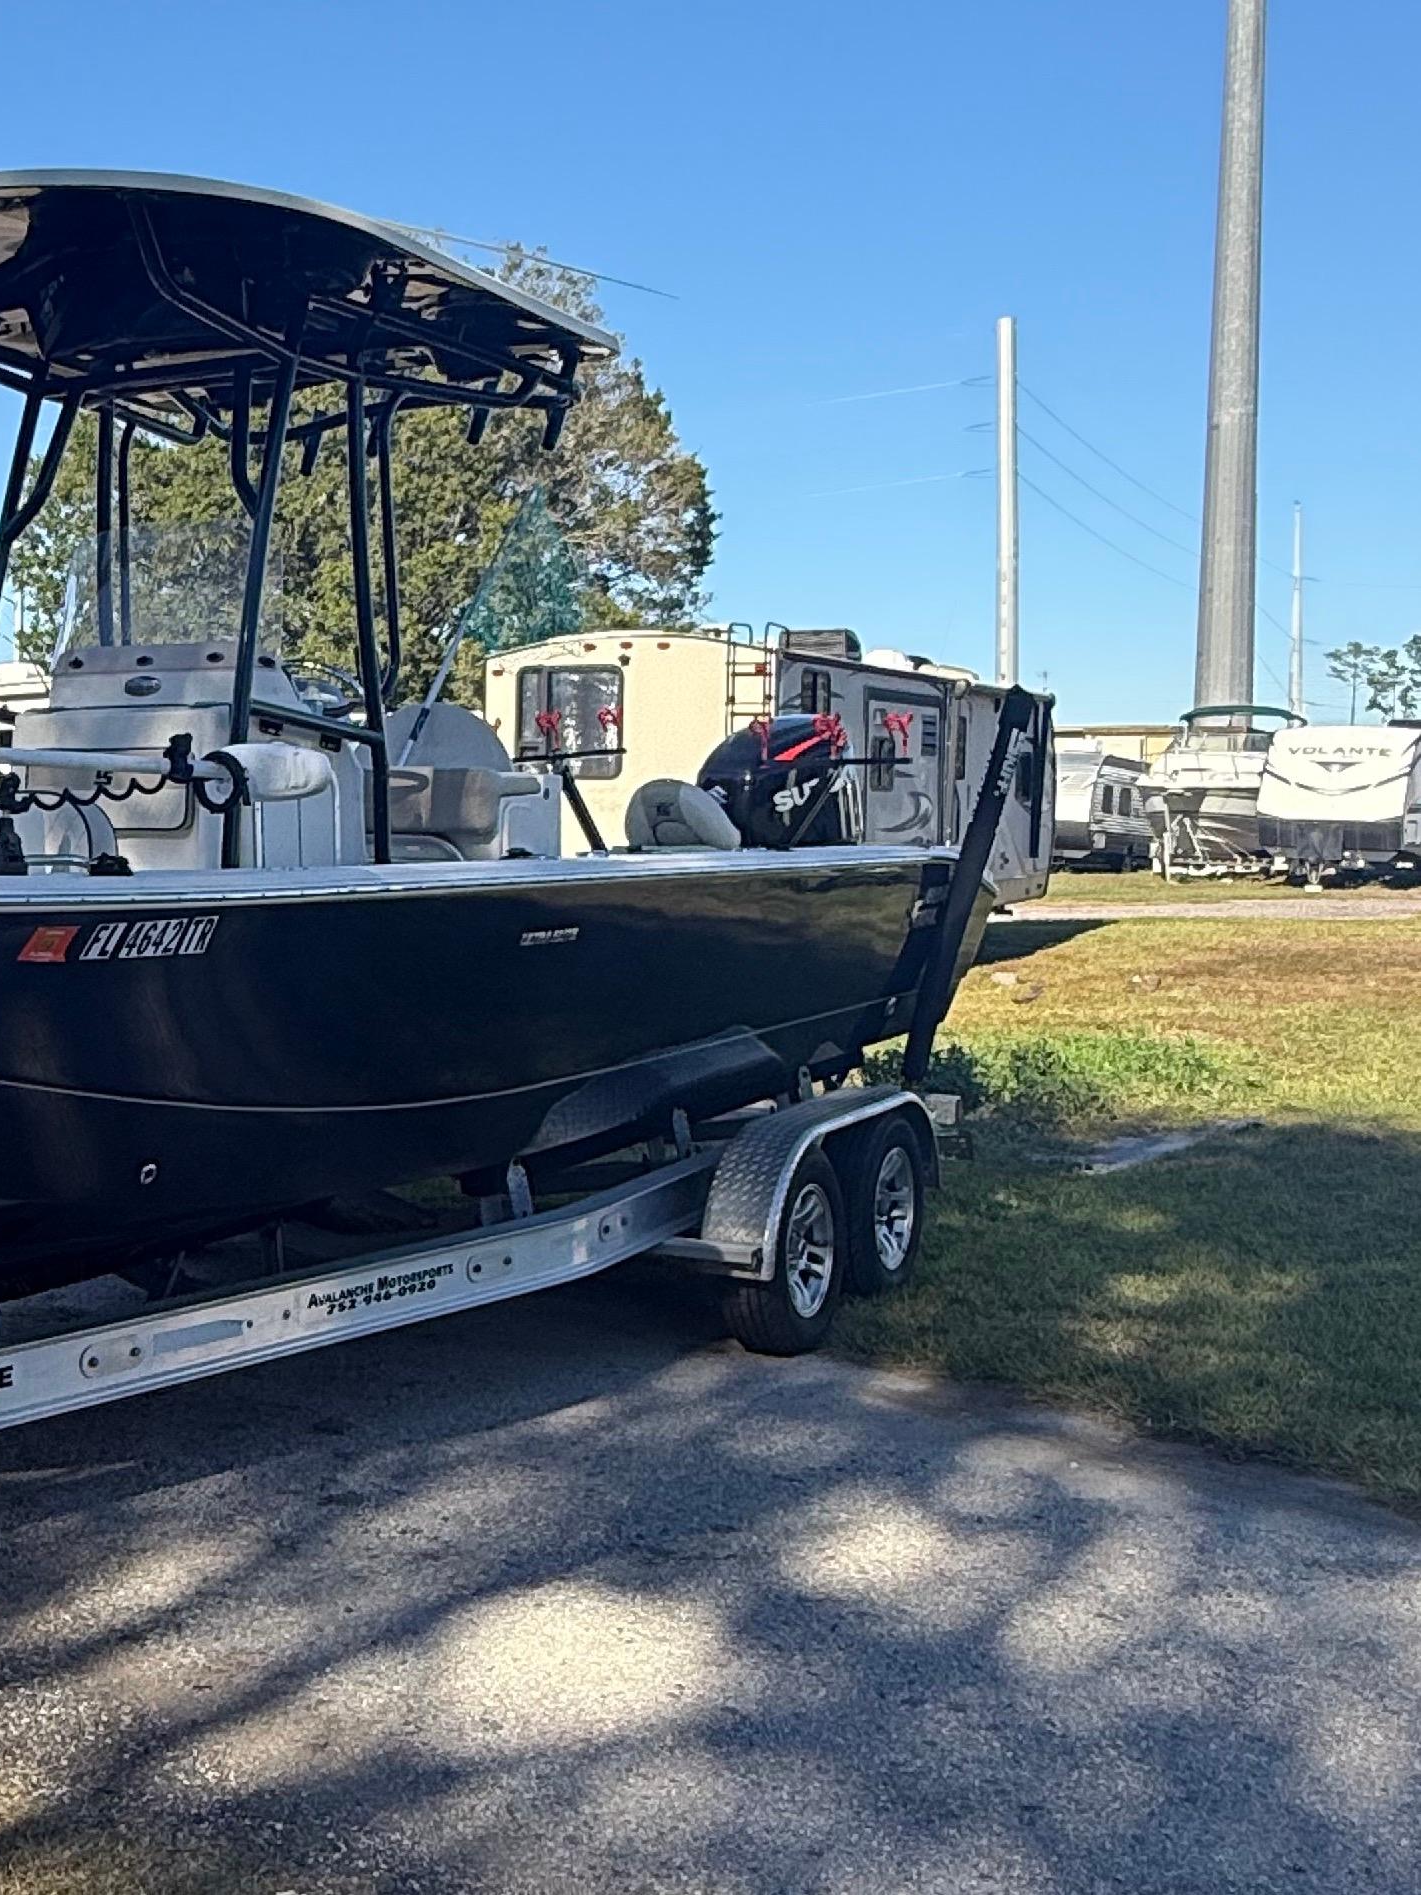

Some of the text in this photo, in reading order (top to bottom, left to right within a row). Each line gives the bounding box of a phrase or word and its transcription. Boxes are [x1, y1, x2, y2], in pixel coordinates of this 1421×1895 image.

[1288, 747, 1392, 758] VOLANTE
[80, 923, 125, 959] FL
[123, 918, 188, 957] 4642
[180, 916, 218, 955] TR
